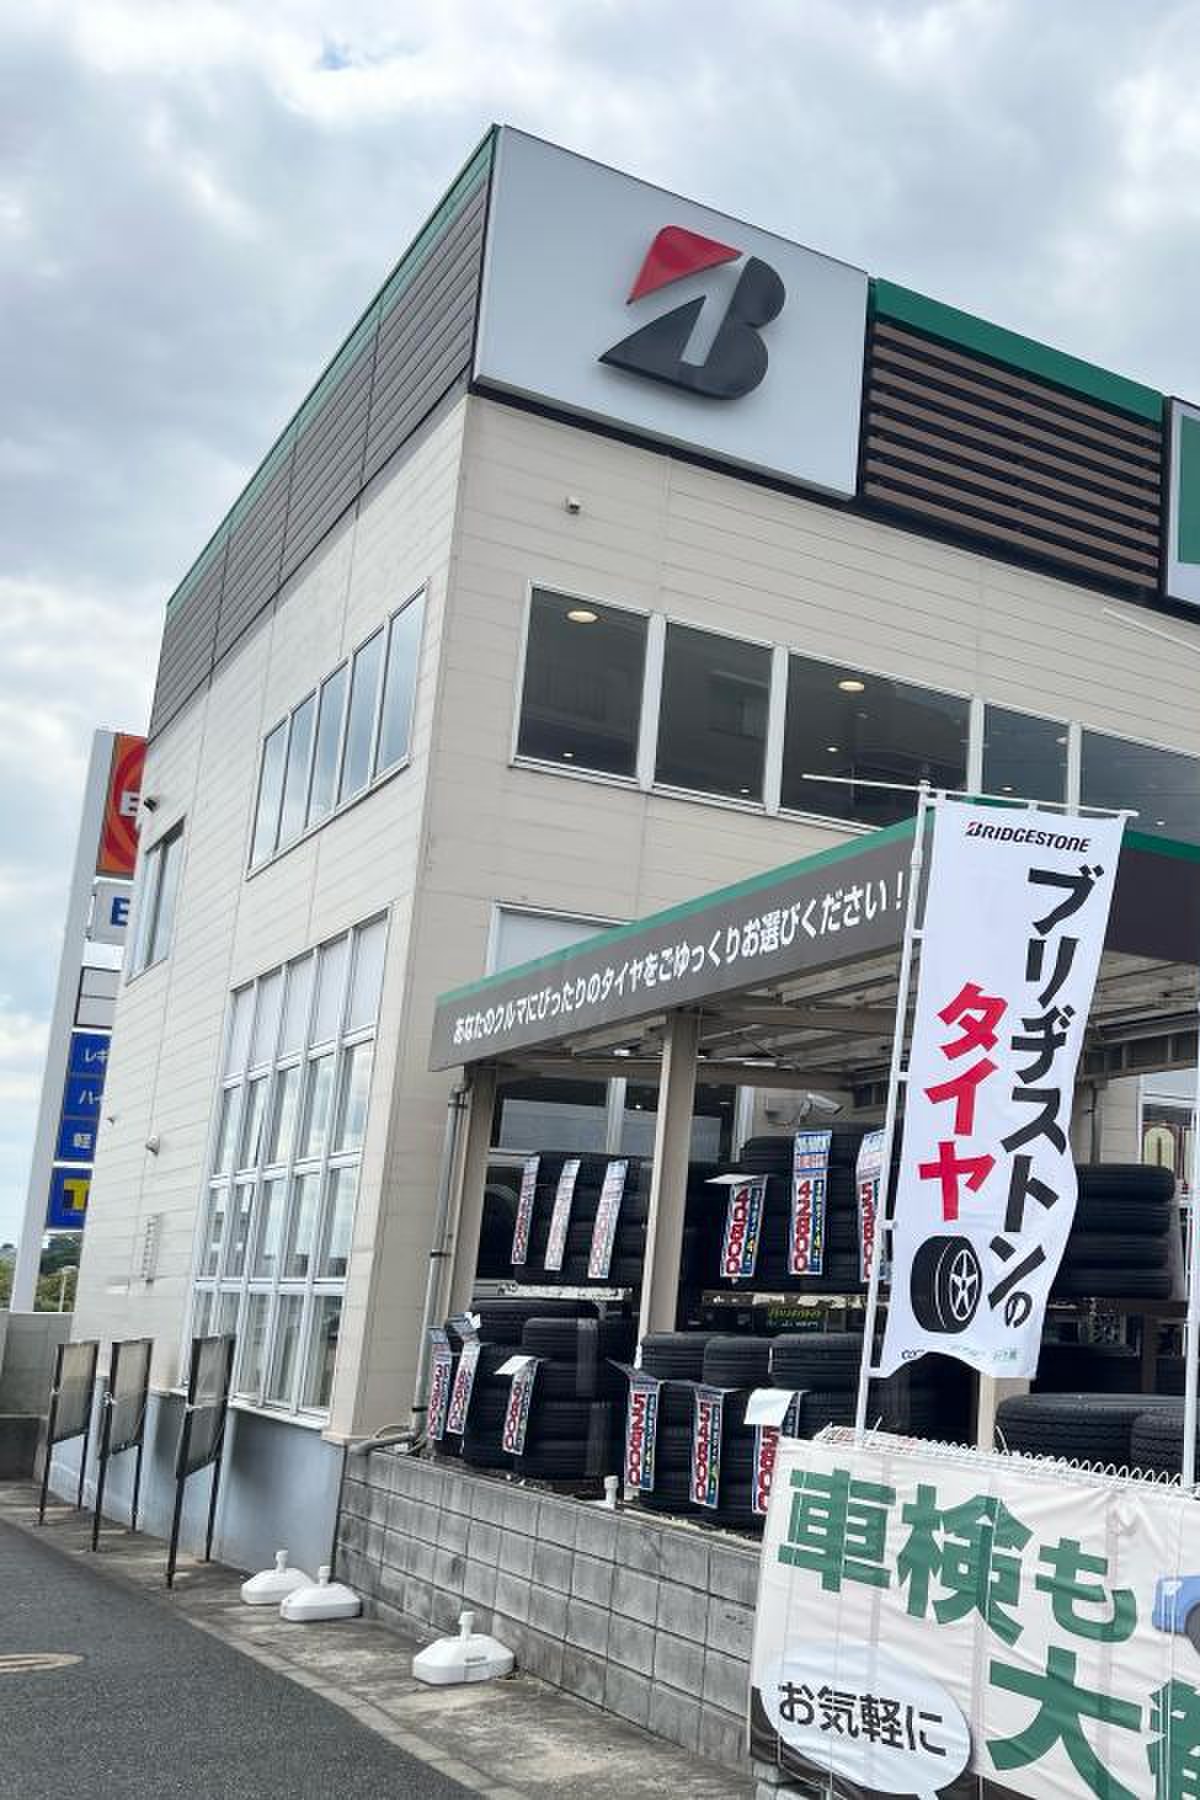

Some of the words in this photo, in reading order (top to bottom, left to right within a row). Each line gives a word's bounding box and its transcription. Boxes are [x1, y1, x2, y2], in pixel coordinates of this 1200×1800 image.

[965, 821, 1091, 853] BRIDGESTONE
[919, 982, 1009, 1221] タイヤ
[987, 863, 1104, 1329] ブリヂストンの
[777, 1467, 1139, 1647] 車検も
[778, 1681, 946, 1757] お気軽に
